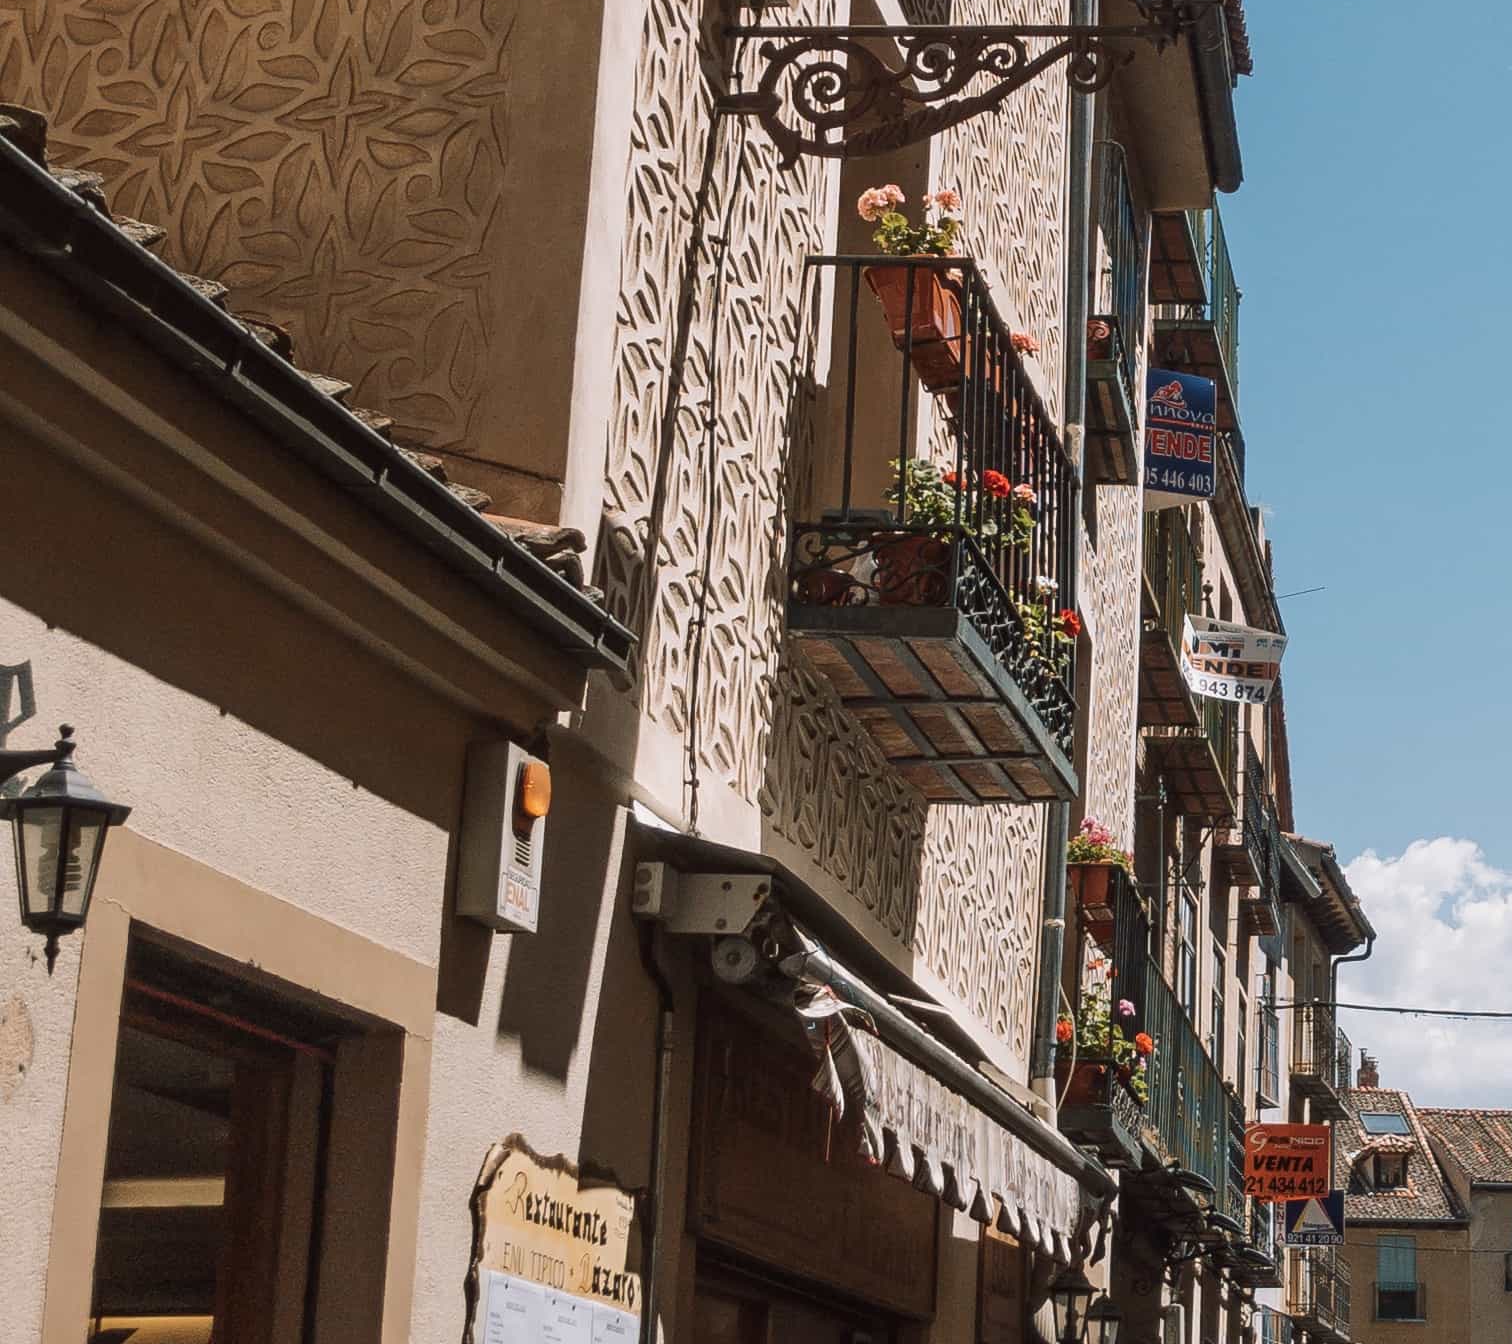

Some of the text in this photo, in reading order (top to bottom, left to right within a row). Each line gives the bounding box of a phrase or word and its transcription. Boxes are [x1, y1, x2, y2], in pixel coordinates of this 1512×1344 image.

[1161, 469, 1184, 489] 446
[1188, 472, 1211, 493] 403
[1191, 657, 1265, 678] ENDE
[1199, 679, 1228, 697] 943
[1253, 1155, 1313, 1172] VENTA
[1267, 1177, 1295, 1193] 434
[1298, 1177, 1325, 1194] 412
[1277, 1203, 1285, 1242] ENTA
